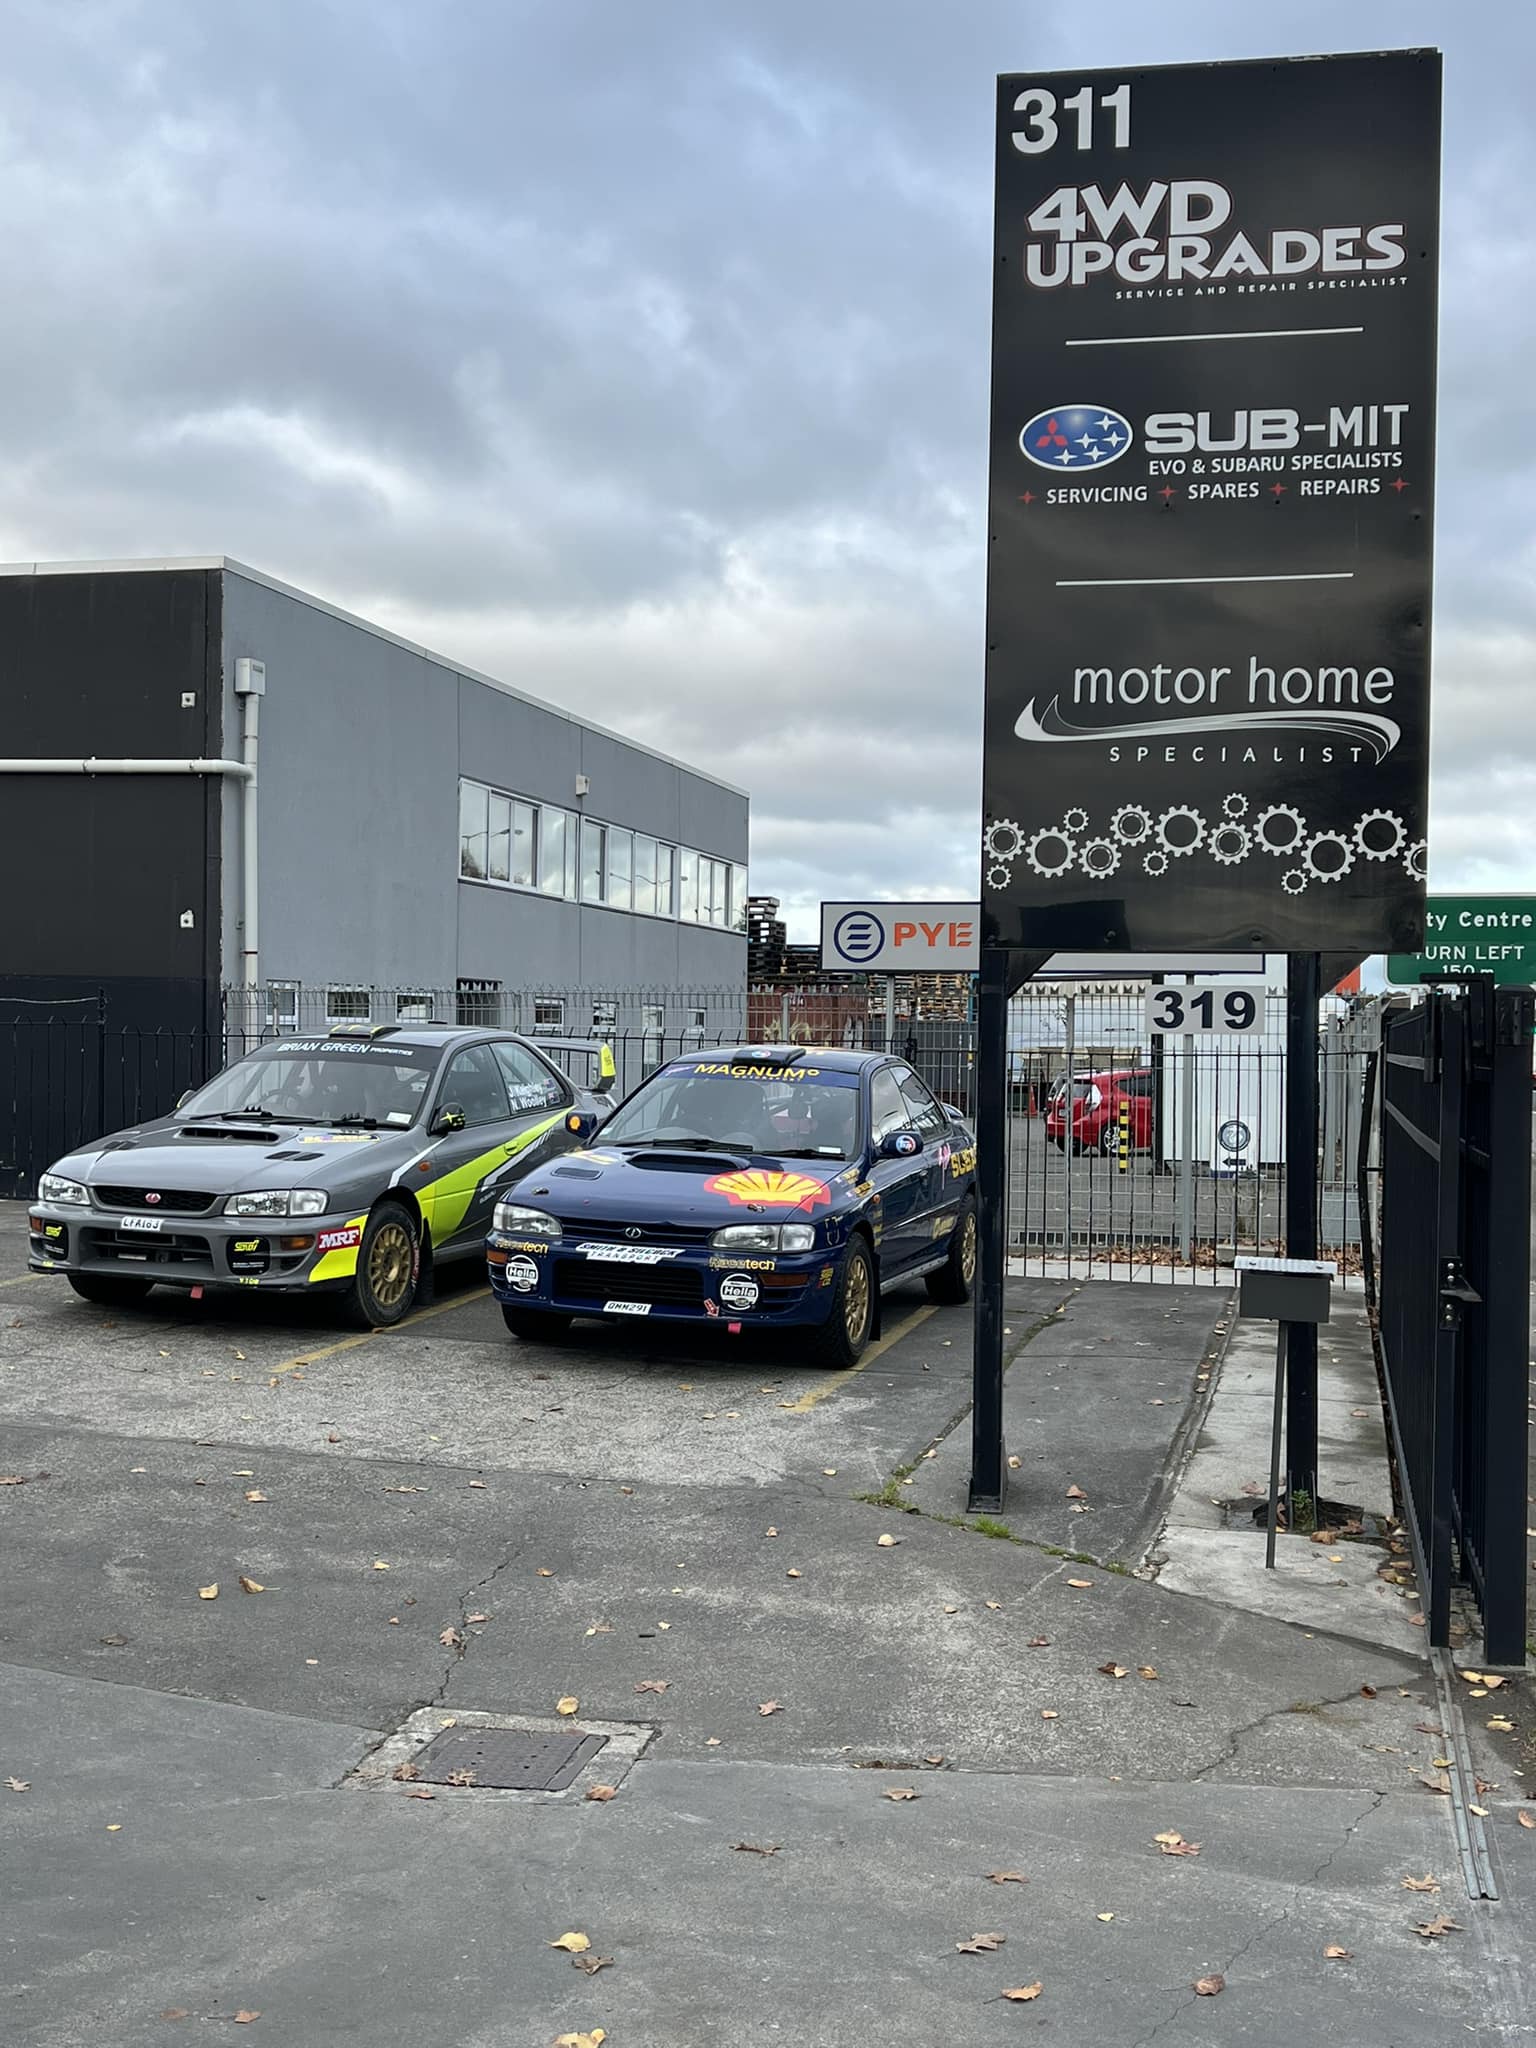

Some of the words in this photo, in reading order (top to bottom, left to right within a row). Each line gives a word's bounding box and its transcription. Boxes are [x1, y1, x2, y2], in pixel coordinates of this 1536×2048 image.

[1011, 84, 1131, 154] 311
[1027, 180, 1231, 241] 4WD
[1026, 224, 1404, 287] UPGRADES
[1115, 287, 1185, 300] SERVICE
[1195, 285, 1227, 295] AND
[1238, 282, 1297, 293] REPAIR
[1308, 277, 1409, 290] SPECIALIST
[1144, 404, 1410, 454] SUB-MIT
[1149, 459, 1186, 475] EVO
[1192, 458, 1206, 474] &
[1211, 456, 1285, 474] SUBARU
[1291, 452, 1403, 471] SPECIALISTS
[1046, 486, 1148, 504] SERVICING
[1188, 482, 1260, 500] SPARES
[1300, 478, 1381, 496] REPAIRS
[1073, 663, 1231, 704] motor
[1248, 656, 1395, 704] home
[1109, 747, 1362, 763] SPECIALIST
[1426, 912, 1447, 931] ty
[1459, 911, 1533, 927] Centre
[894, 922, 973, 947] PYE
[1417, 946, 1466, 960] URN
[1475, 946, 1525, 960] LEFT
[1153, 990, 1256, 1029] 319
[278, 1042, 320, 1052] BRIAN
[321, 1042, 370, 1054] GREEN
[318, 1230, 360, 1249] MRF
[507, 1267, 536, 1279] Hella
[709, 1256, 775, 1271] Racetech
[724, 1286, 756, 1297] Hella
